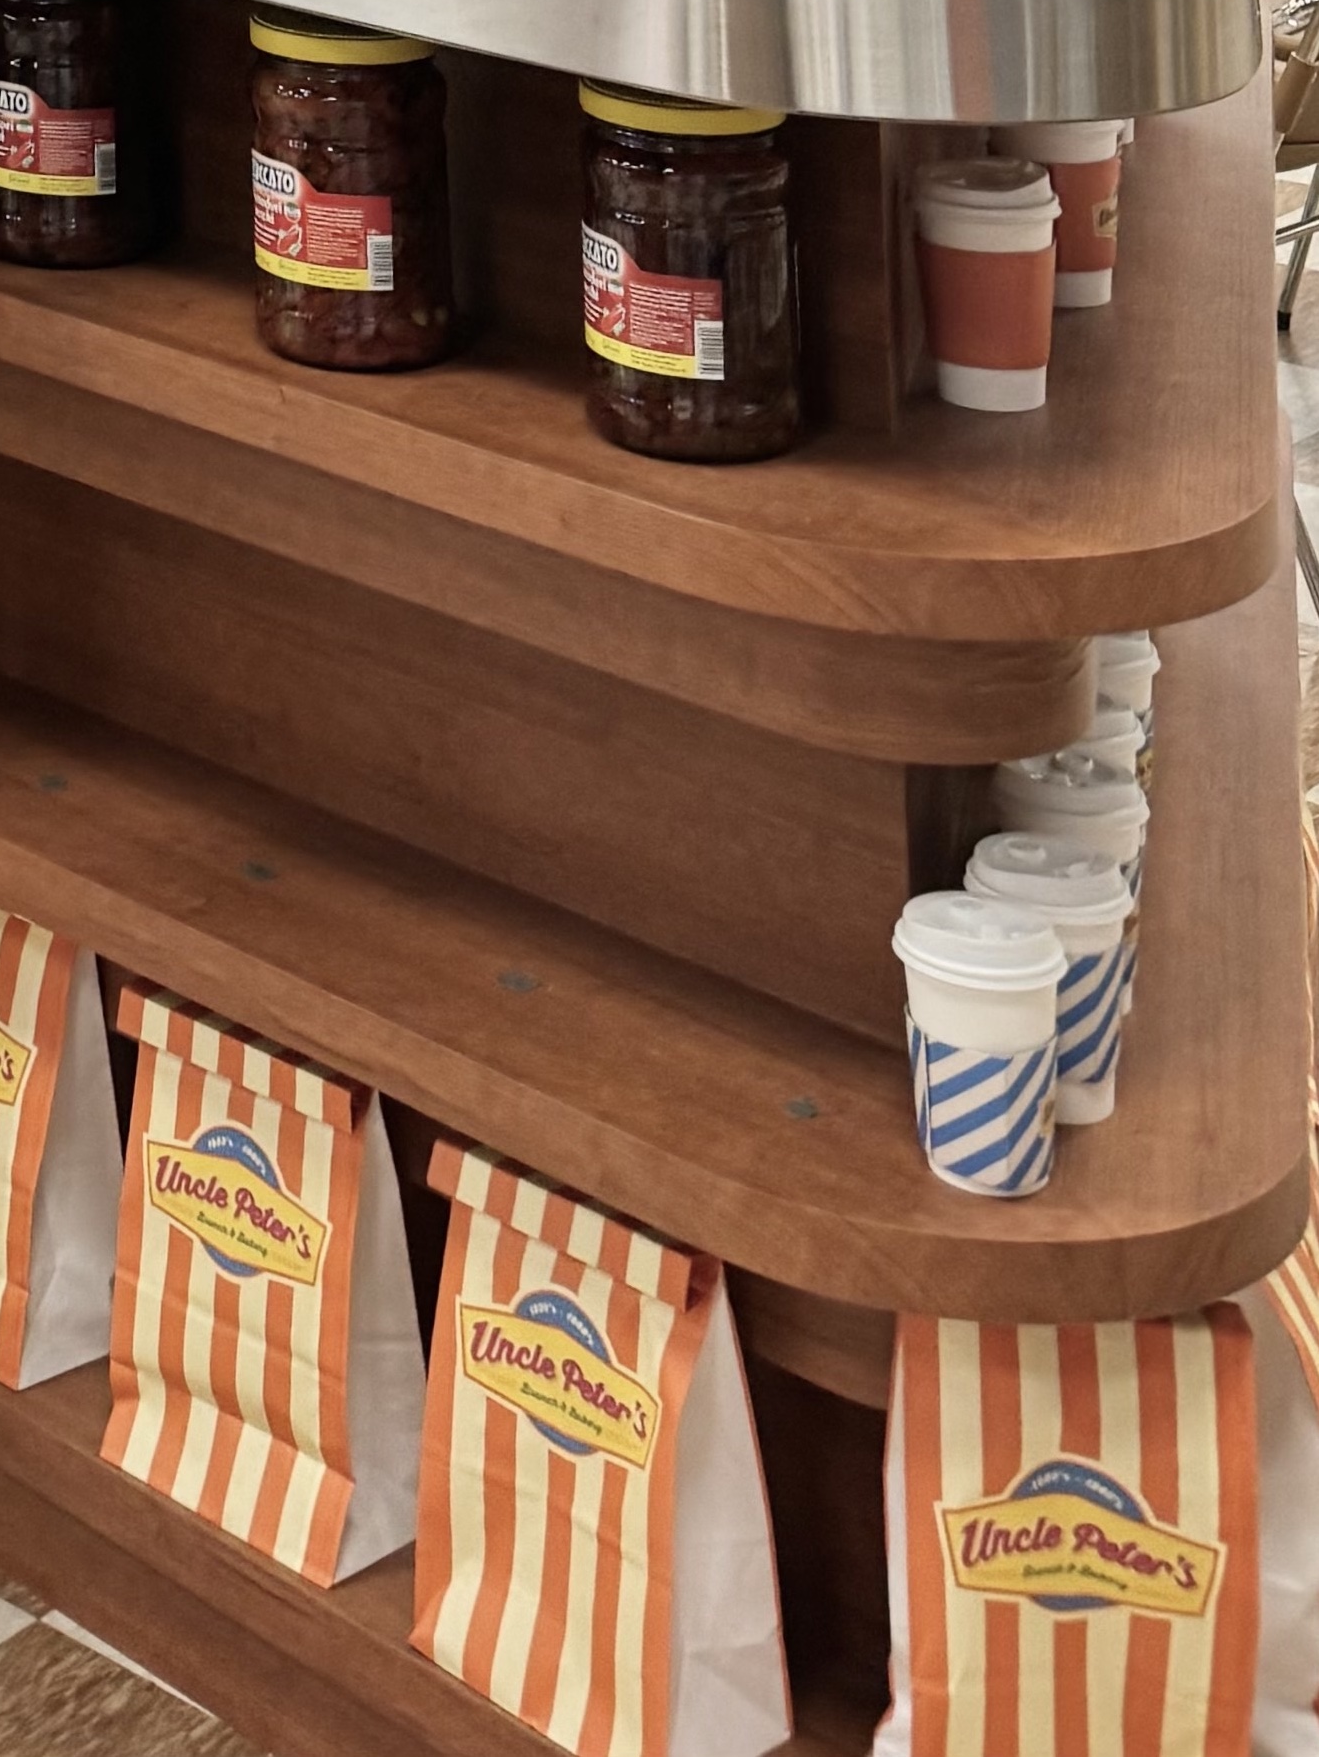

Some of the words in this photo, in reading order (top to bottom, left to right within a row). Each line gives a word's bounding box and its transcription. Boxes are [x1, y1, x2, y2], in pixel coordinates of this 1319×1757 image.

[155, 1155, 229, 1209] Uncle
[233, 1187, 312, 1260] Peter's
[470, 1320, 557, 1379] Uncle
[561, 1358, 647, 1440] Peter's
[961, 1516, 1063, 1569] Uncle
[1072, 1522, 1198, 1590] Peter's
